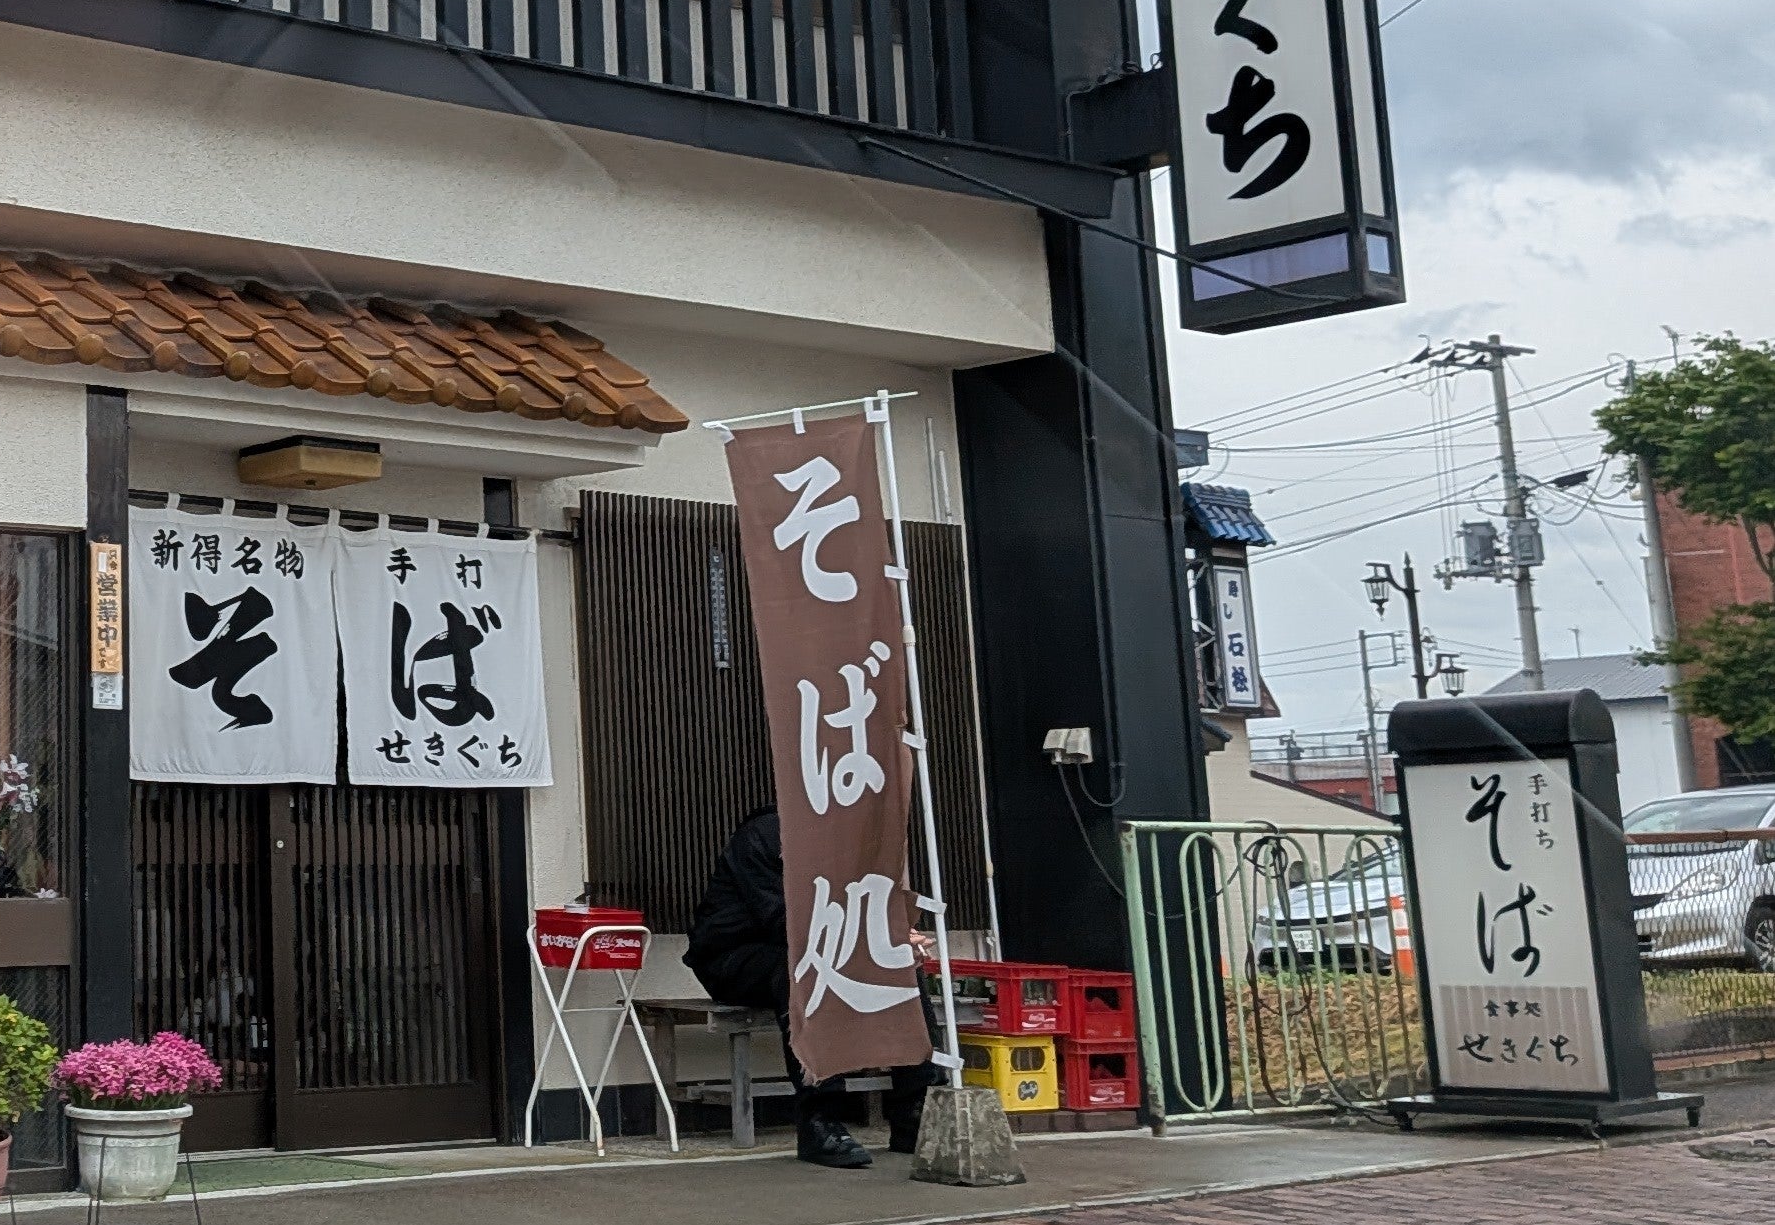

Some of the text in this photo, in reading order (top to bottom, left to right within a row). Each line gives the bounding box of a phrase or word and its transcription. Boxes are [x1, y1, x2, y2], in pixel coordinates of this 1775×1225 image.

[151, 528, 304, 580] 新得名物
[386, 547, 483, 590] 手打
[97, 573, 118, 648] 営業中
[168, 586, 502, 731] そば
[375, 729, 522, 768] せきぐち
[772, 455, 920, 1017] そば処
[1527, 773, 1556, 850] 手打ち
[1466, 773, 1555, 978] そば
[1483, 999, 1542, 1018] 食事処
[1456, 1033, 1579, 1067] せきぐち
